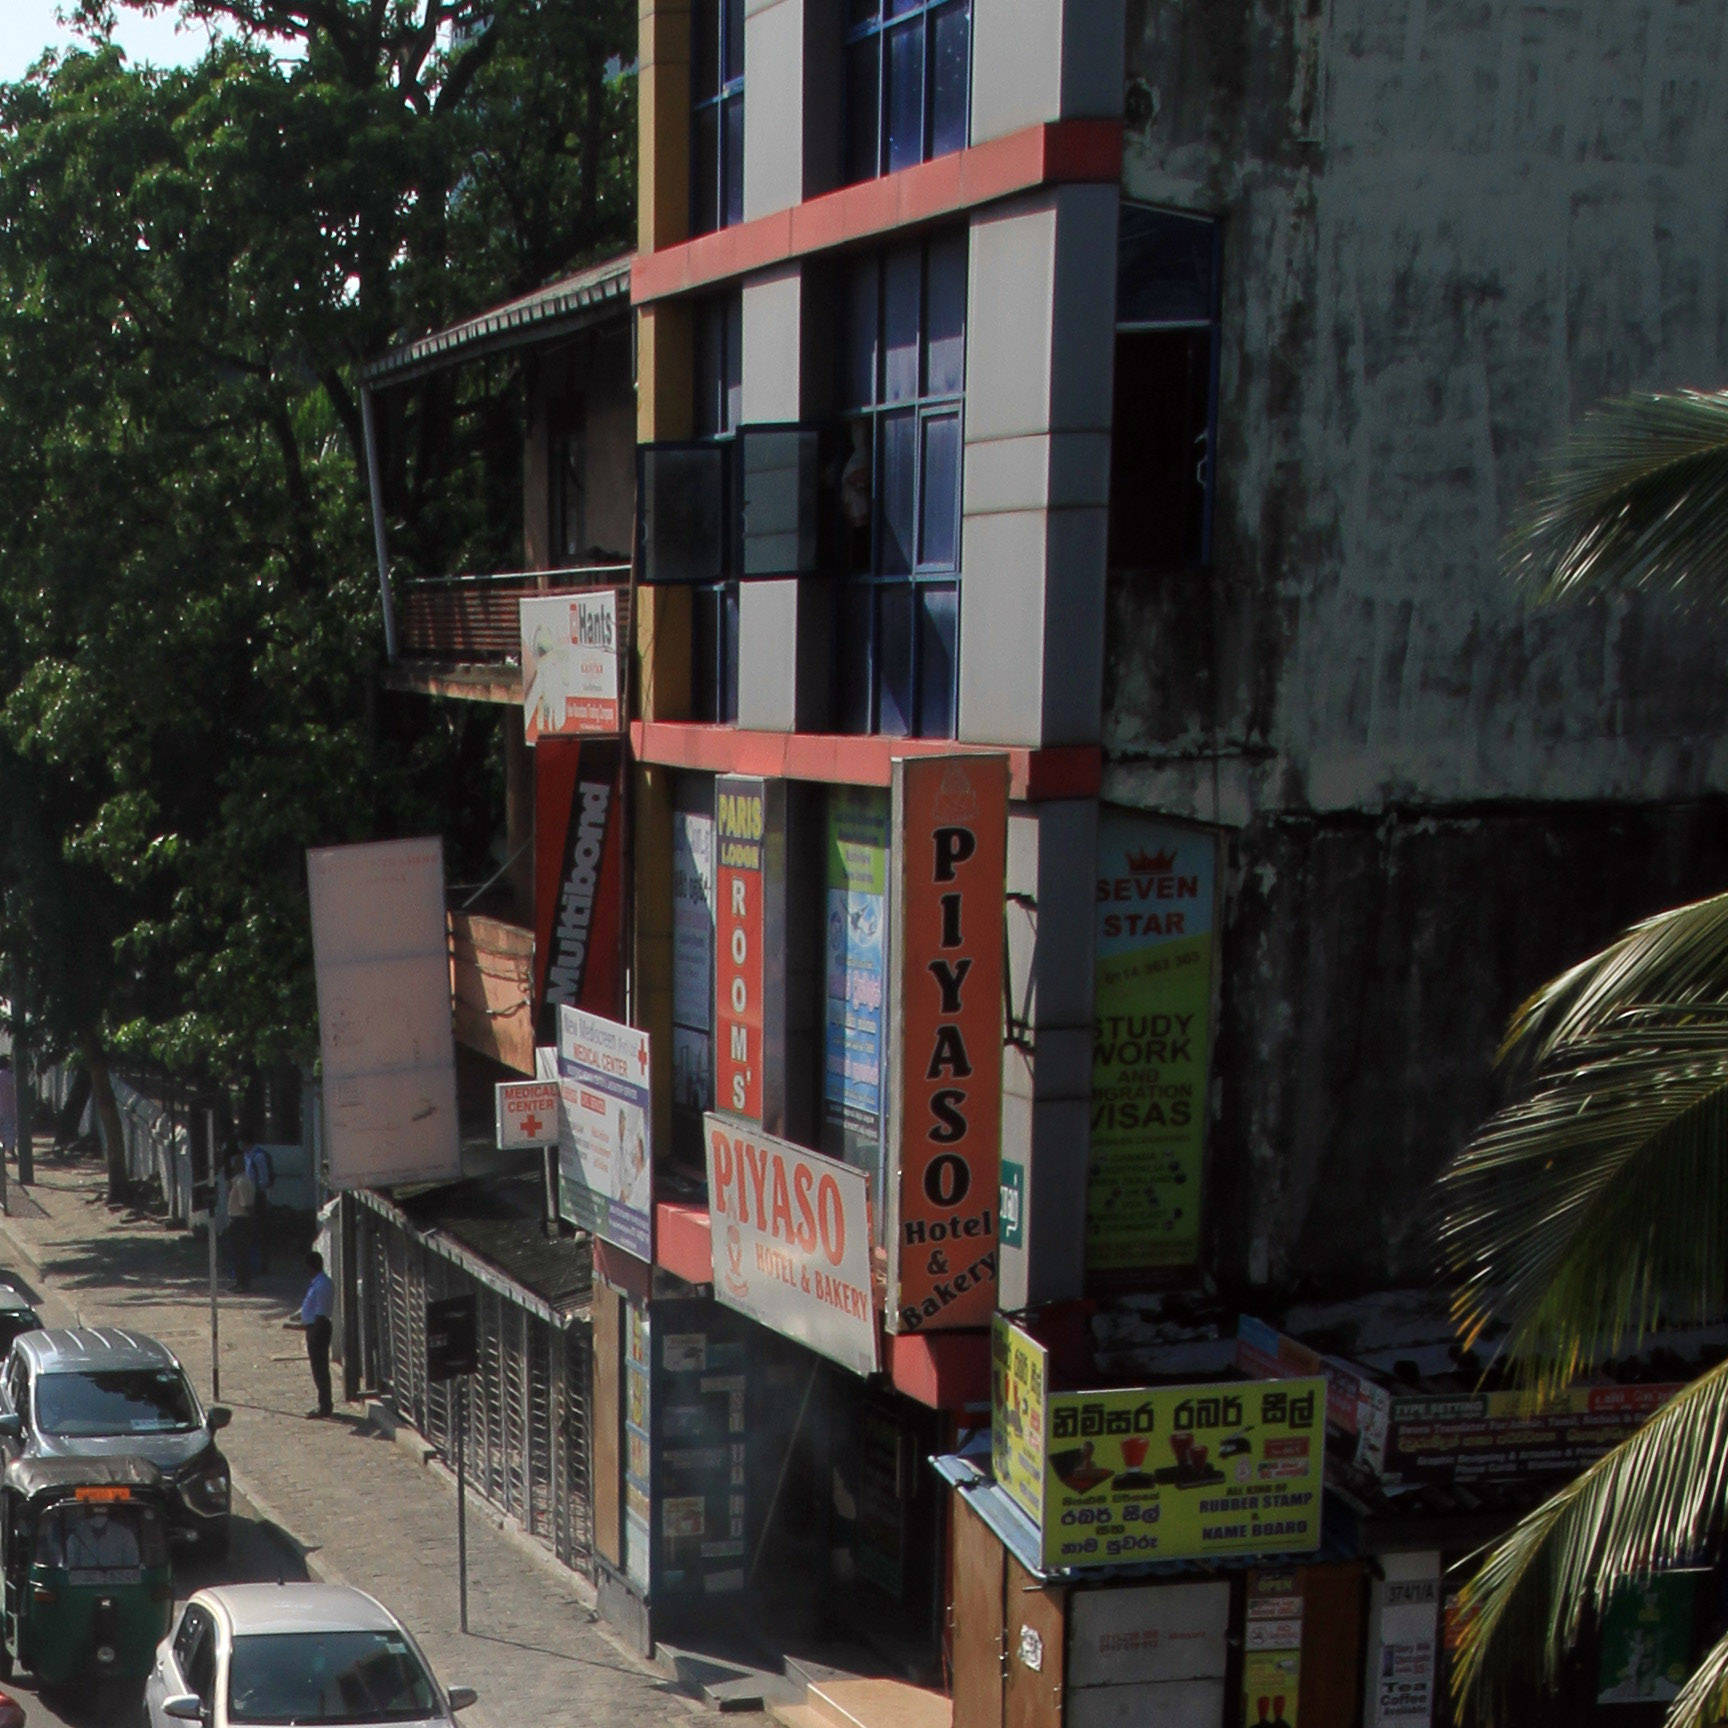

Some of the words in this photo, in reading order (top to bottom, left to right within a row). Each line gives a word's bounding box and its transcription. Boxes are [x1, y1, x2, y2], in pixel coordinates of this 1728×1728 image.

[718, 794, 762, 841] PARIS
[721, 843, 760, 870] LODGE
[546, 782, 610, 1004] Multibond
[1096, 875, 1198, 902] SEVEN
[1103, 912, 1185, 937] STAR
[923, 825, 978, 1209] PIYASO
[573, 1042, 600, 1068] MEDICAL
[602, 1053, 628, 1078] CENTER
[1118, 1069, 1159, 1083] AND
[505, 1083, 559, 1100] MEDICAL
[508, 1099, 555, 1113] CENTER
[711, 1130, 845, 1267] PIYASO
[905, 1209, 993, 1246] Hotel
[926, 1248, 950, 1277] &
[755, 1242, 797, 1288] HOTEL
[800, 1264, 812, 1295] &
[815, 1269, 868, 1323] BAKERY
[901, 1249, 998, 1332] Bakery
[1200, 1498, 1258, 1513] RUBBER
[1262, 1493, 1313, 1509] STAMP
[1203, 1524, 1248, 1540] NAME
[1252, 1520, 1308, 1538] BOARD
[1380, 1694, 1427, 1707] Coffee
[1383, 1682, 1427, 1693] Tea
